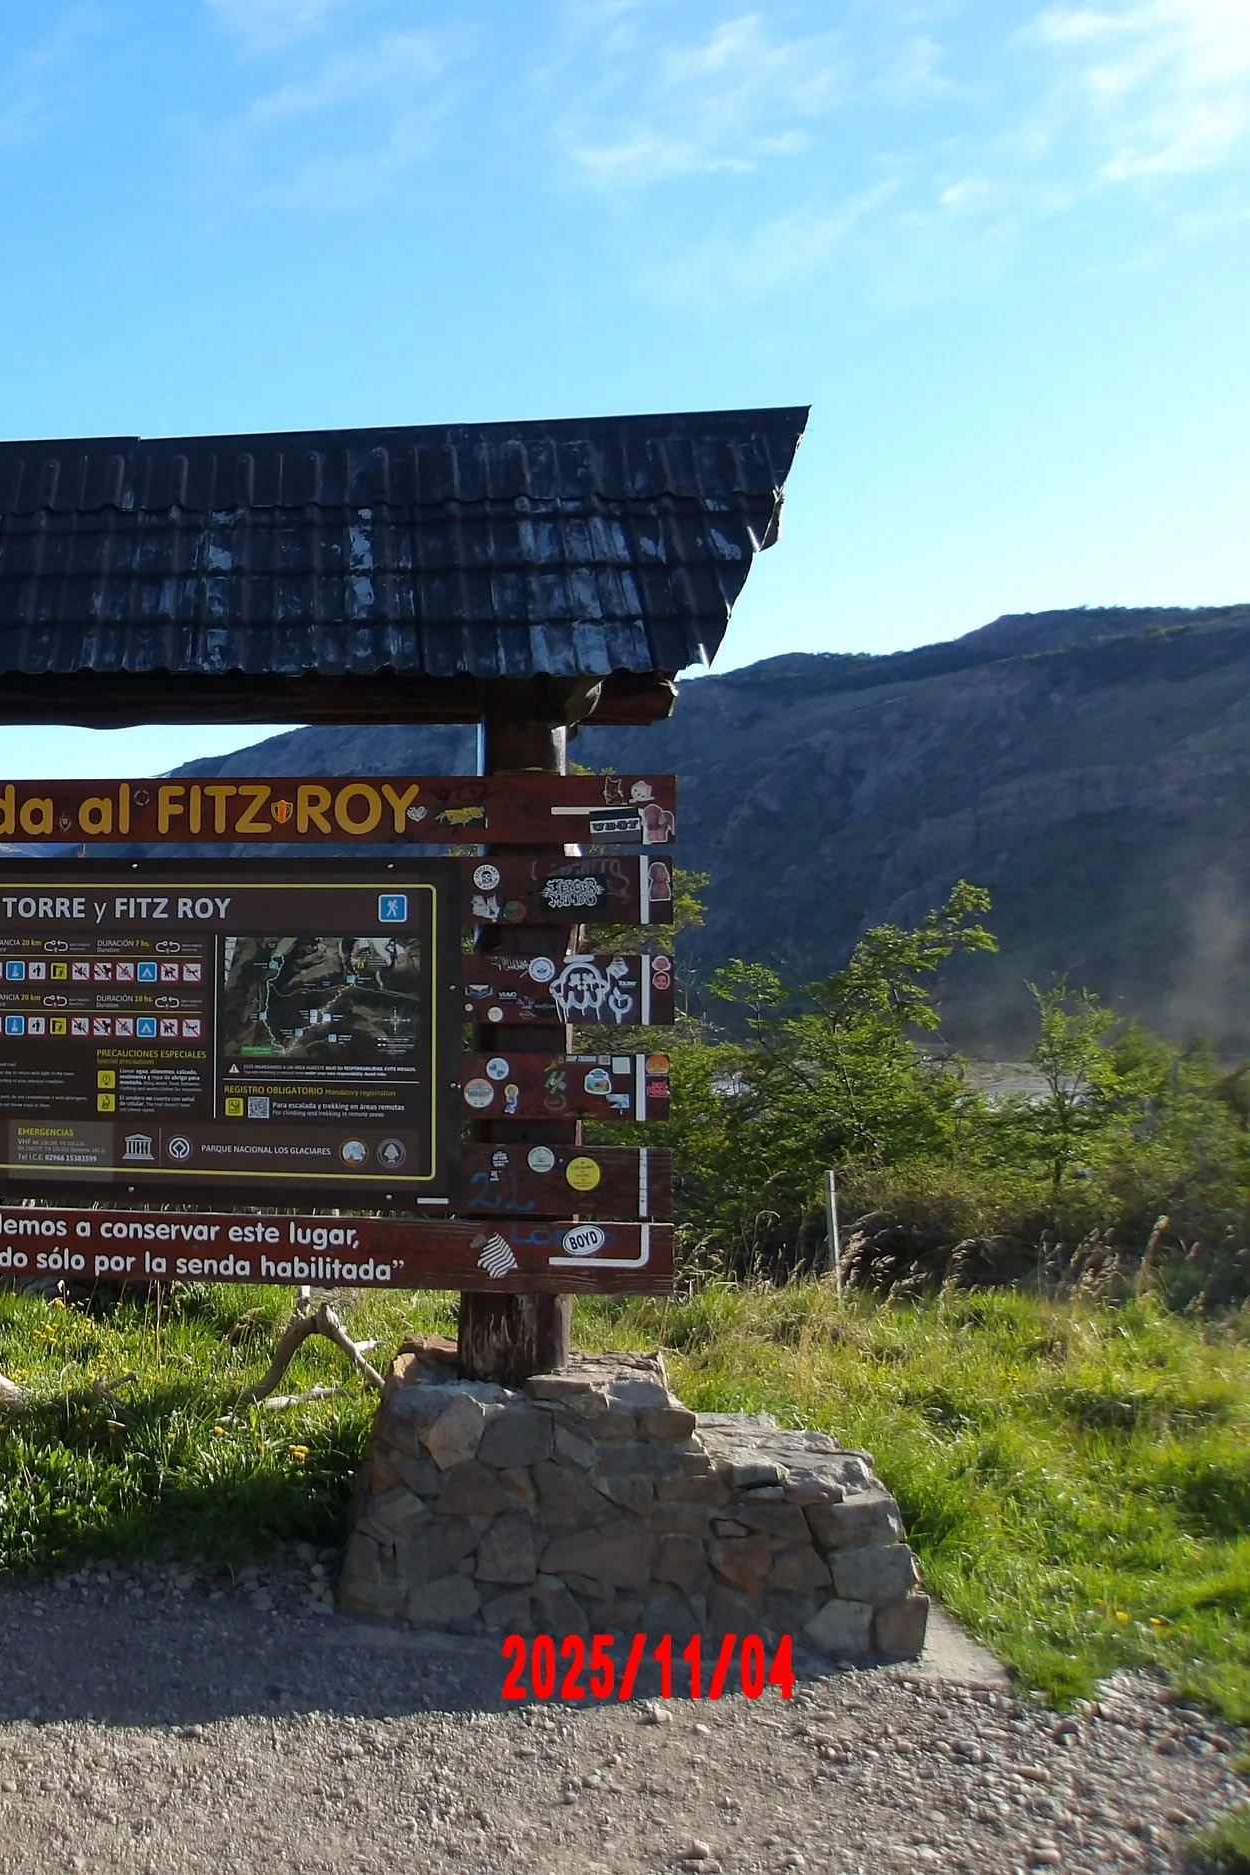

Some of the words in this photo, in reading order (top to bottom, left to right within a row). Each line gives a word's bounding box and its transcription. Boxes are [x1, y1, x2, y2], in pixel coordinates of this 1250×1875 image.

[78, 783, 130, 835] al
[158, 784, 272, 835] FITZ
[297, 784, 420, 835] ROY
[2, 897, 86, 918] TORRE
[94, 902, 108, 924] y
[115, 897, 169, 919] FITZ
[177, 897, 232, 919] ROY
[97, 939, 134, 947] DURACIÓN
[96, 994, 134, 1002] DURACIÓN
[96, 1049, 158, 1058] PRECAUCIONES
[160, 1050, 207, 1058] ESPECIALES
[224, 1085, 264, 1095] REGISTRO
[267, 1086, 324, 1095] OBLIGATORIO
[325, 1088, 359, 1097] Mandatory
[322, 1103, 349, 1111] trekking
[18, 1128, 74, 1136] EMERGENCIAS
[201, 1144, 232, 1154] PARQUE
[233, 1145, 273, 1154] NACIONAL
[274, 1146, 289, 1154] LOS
[290, 1146, 331, 1155] GLACIARES
[75, 1222, 91, 1238] a
[99, 1223, 220, 1242] conservar
[228, 1224, 280, 1244] este
[289, 1224, 360, 1251] lugar,
[568, 1231, 599, 1250] BOYD
[36, 1248, 85, 1271] sólo
[94, 1254, 136, 1277] por
[144, 1250, 167, 1274] la
[176, 1252, 250, 1276] senda
[260, 1254, 406, 1282] habilitada”
